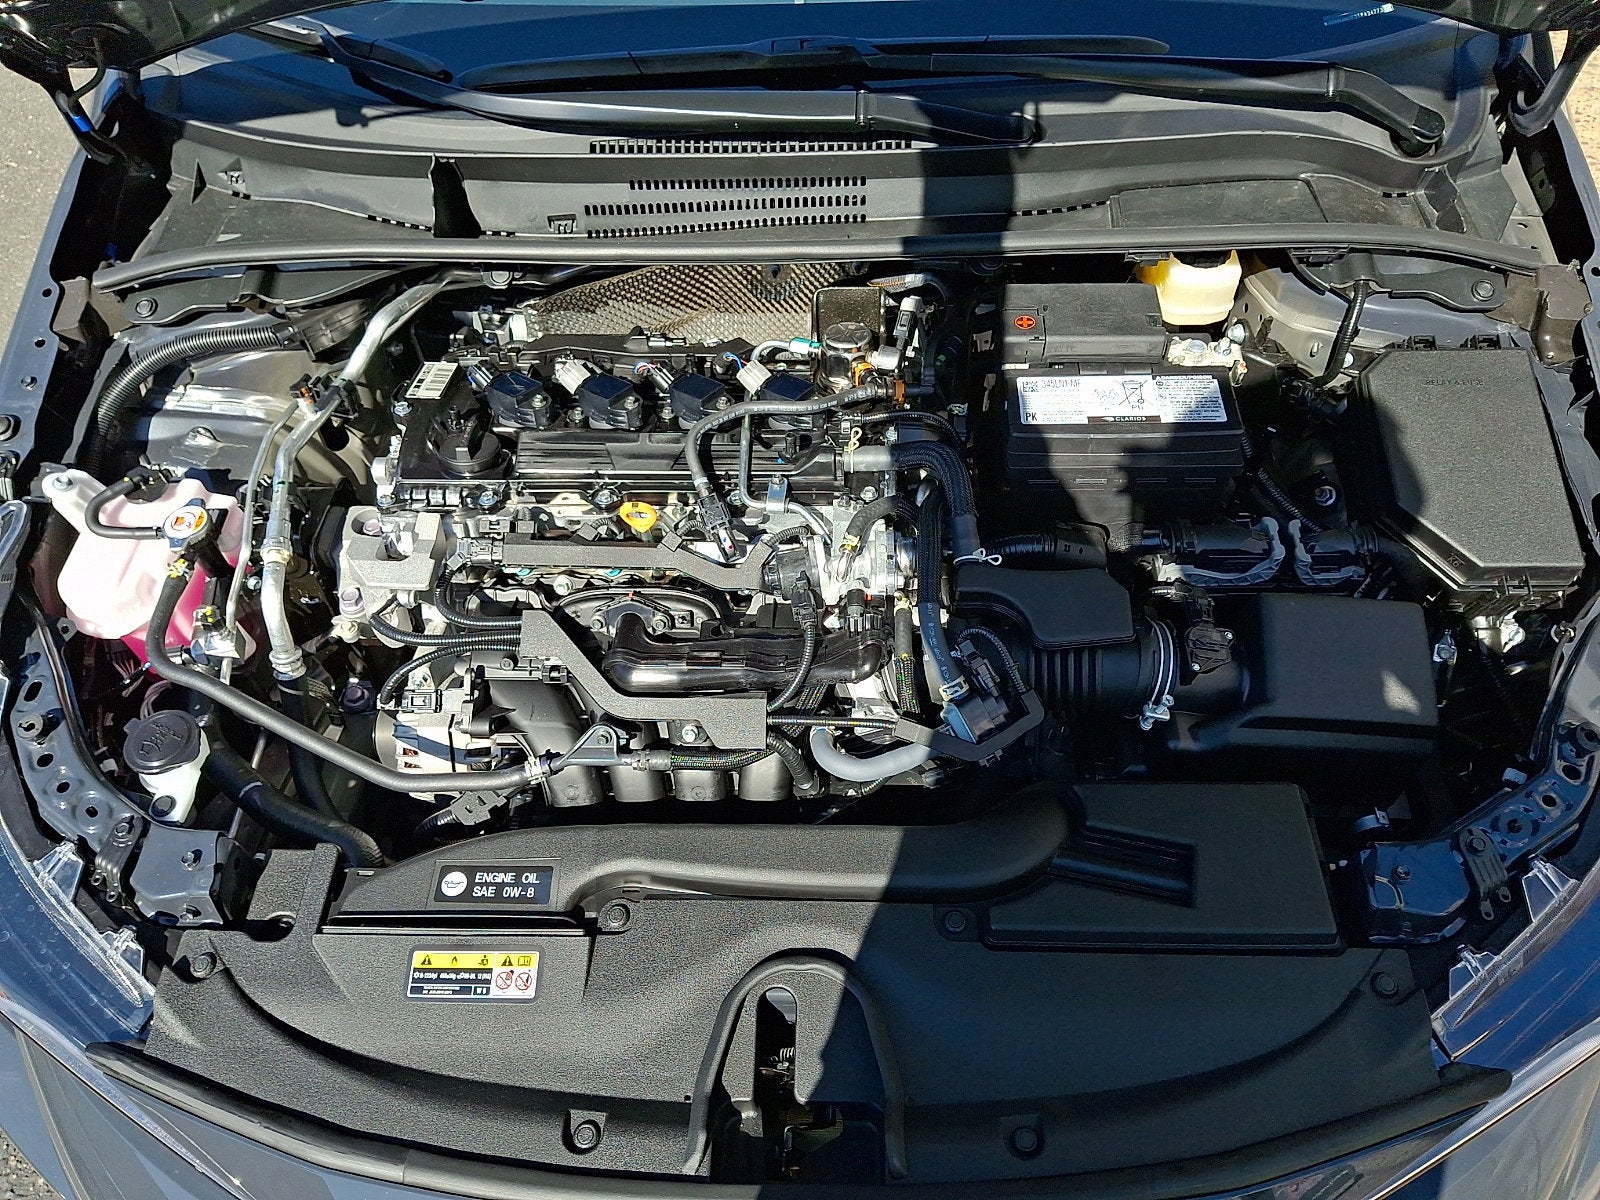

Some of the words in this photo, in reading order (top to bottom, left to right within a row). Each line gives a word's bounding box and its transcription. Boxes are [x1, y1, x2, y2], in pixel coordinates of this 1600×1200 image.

[1025, 412, 1038, 422] PK
[474, 872, 516, 884] ENGINE
[521, 872, 540, 884] OIL
[472, 886, 497, 898] SAE
[502, 886, 535, 898] 0W-8
